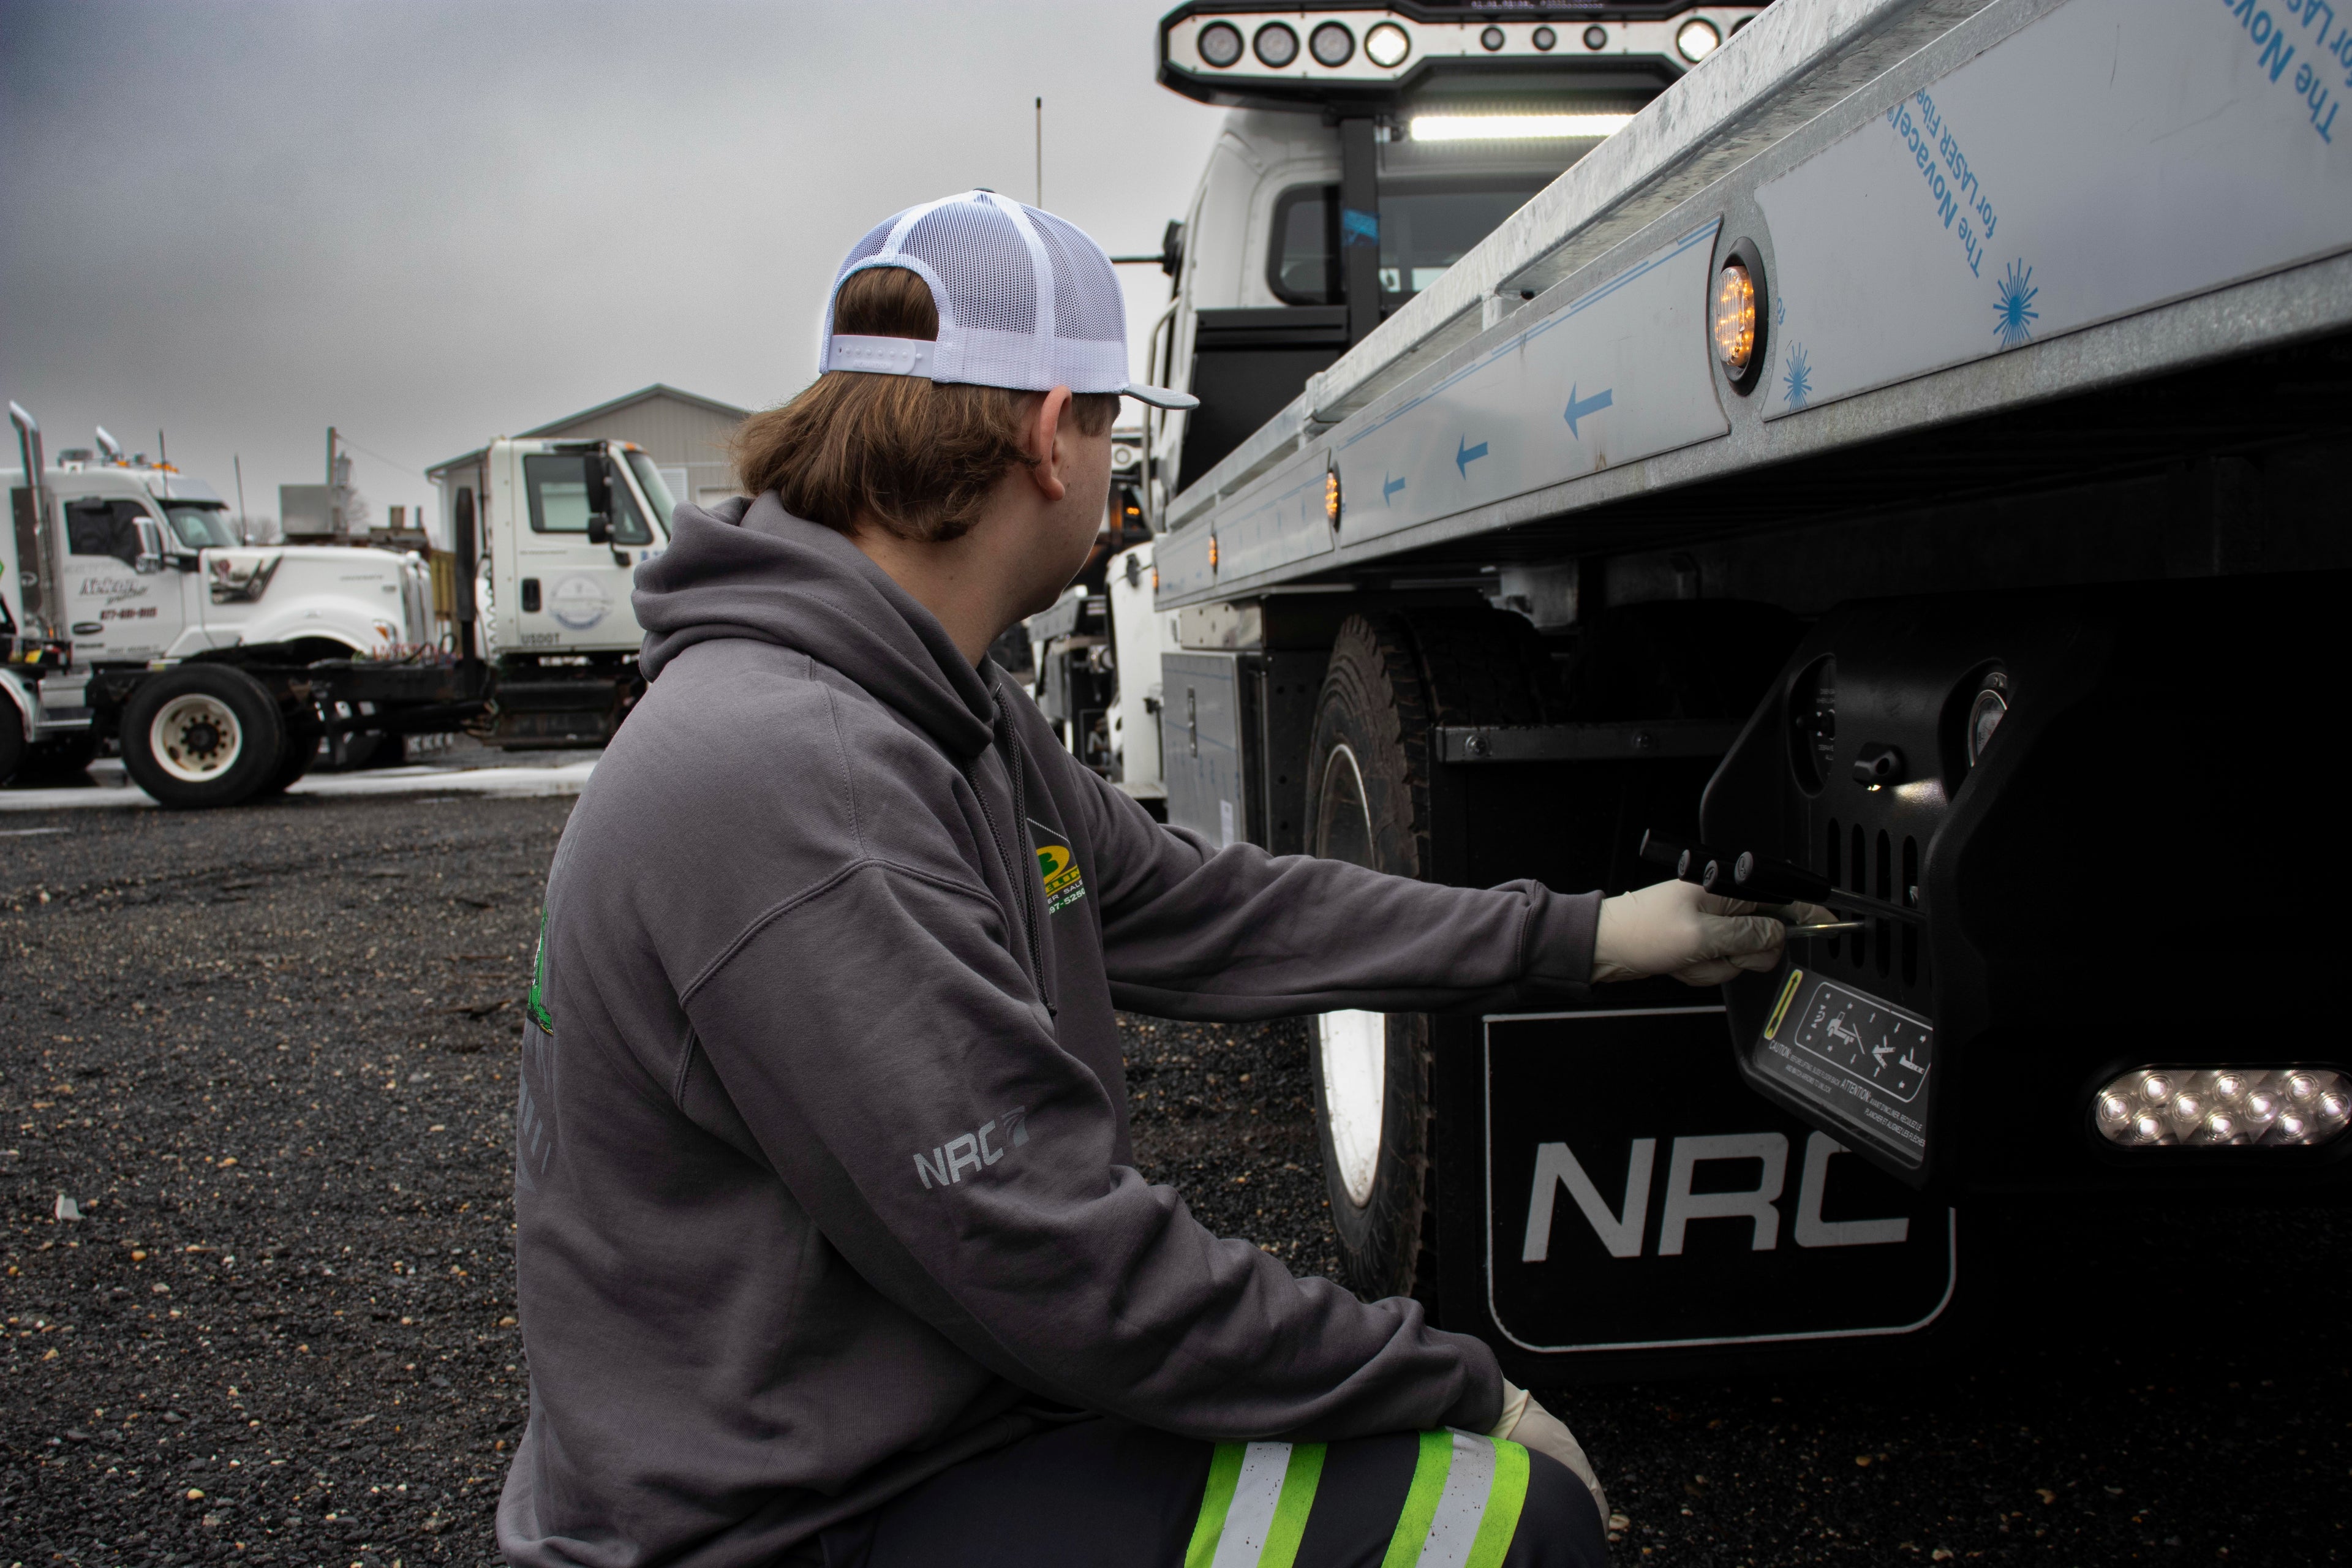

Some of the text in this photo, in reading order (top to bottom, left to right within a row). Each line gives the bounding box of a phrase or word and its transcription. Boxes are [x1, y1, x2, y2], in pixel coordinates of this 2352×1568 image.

[2223, 0, 2339, 145] The Nov
[1939, 124, 1979, 206] LASER
[1975, 195, 1997, 240] for
[1958, 216, 1983, 279] The
[521, 633, 560, 644] USDOT
[1049, 888, 1086, 915] 97-5250
[1769, 1039, 1792, 1059] CAUTION:
[1840, 1079, 1872, 1102] ATTENTION:
[1869, 1098, 1882, 1109] AVANT
[1899, 1114, 1917, 1128] RECULEZ
[1915, 1122, 1923, 1132] LE
[1864, 1108, 1883, 1123] PLANCHER
[1887, 1120, 1902, 1134] ALIGNEZ
[1901, 1128, 1910, 1139] LES
[913, 1120, 1004, 1189] NRC
[1522, 1130, 1910, 1262] NRC
